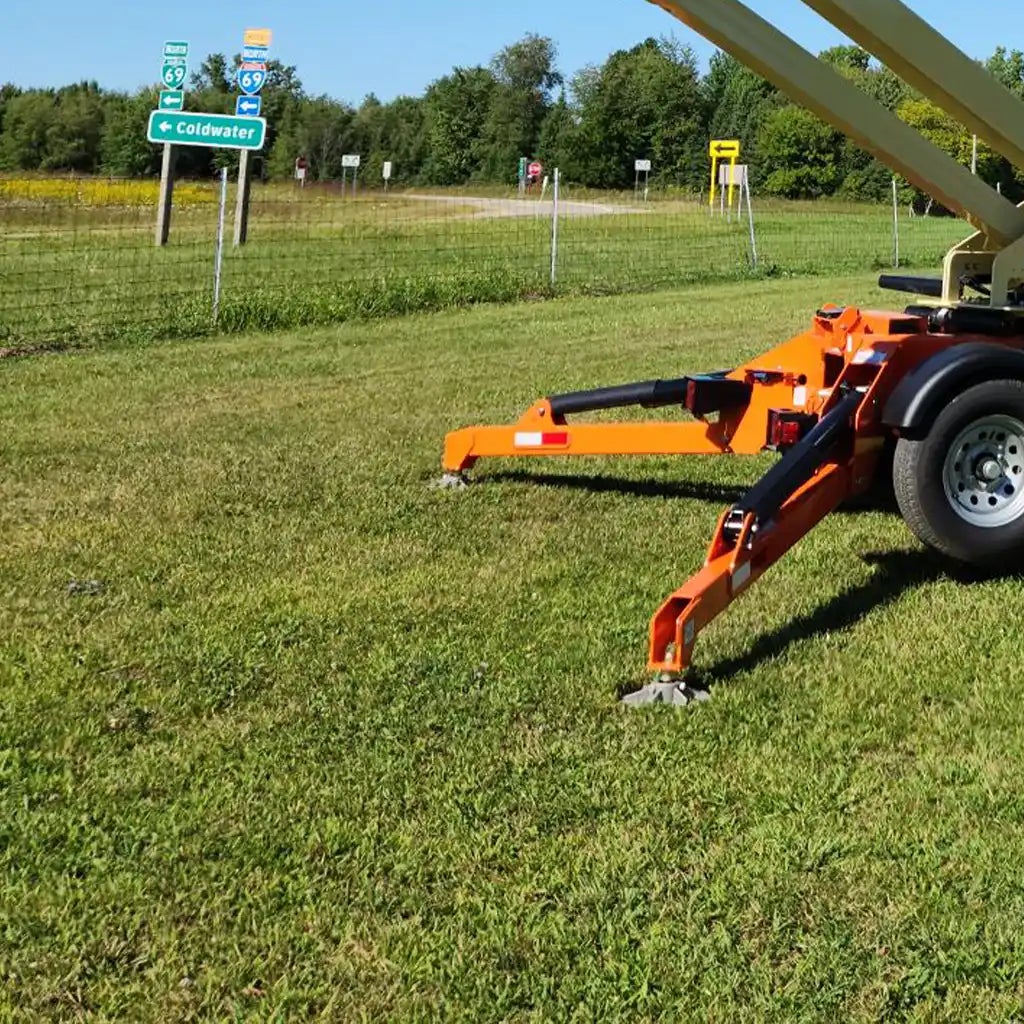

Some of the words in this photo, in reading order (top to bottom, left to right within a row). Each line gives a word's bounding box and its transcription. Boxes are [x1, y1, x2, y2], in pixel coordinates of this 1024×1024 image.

[165, 67, 184, 83] 69
[243, 72, 262, 87] 69
[177, 121, 255, 140] Coldwater
